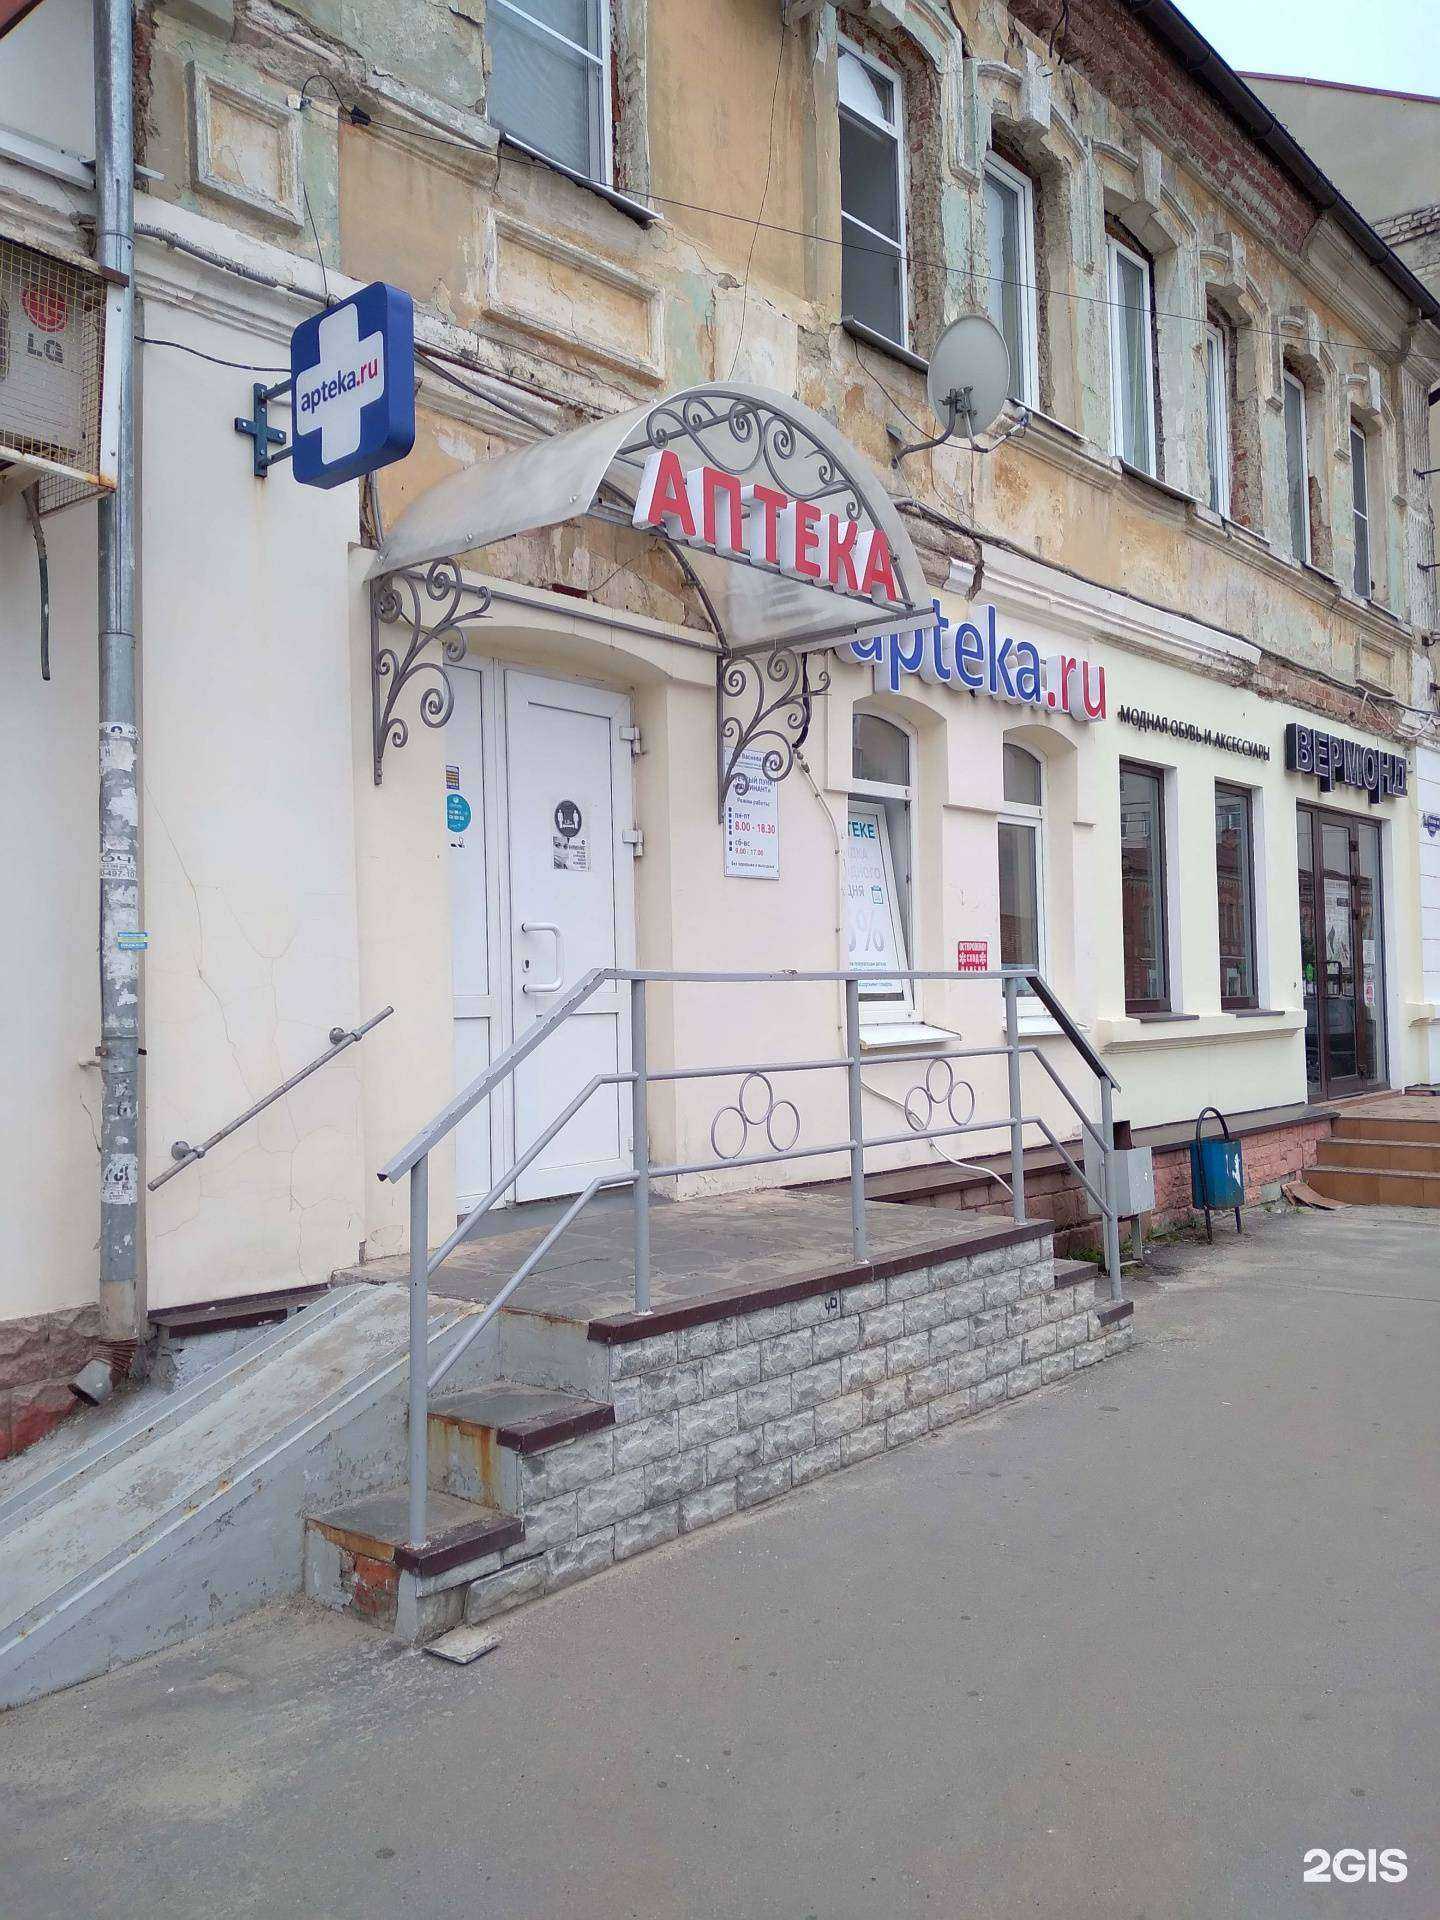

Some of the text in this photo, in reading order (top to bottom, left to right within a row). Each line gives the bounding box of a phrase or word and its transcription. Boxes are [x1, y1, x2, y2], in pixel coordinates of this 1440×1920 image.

[26, 332, 64, 363] LG
[301, 358, 378, 414] apteka.ru
[640, 449, 897, 602] АПТЕКА
[1119, 704, 1271, 762] МОДНАЯ ОБУВЬ И АКСЕССУАРЫ
[1289, 723, 1408, 804] ВЕРМОНД
[734, 820, 751, 832] 8.00
